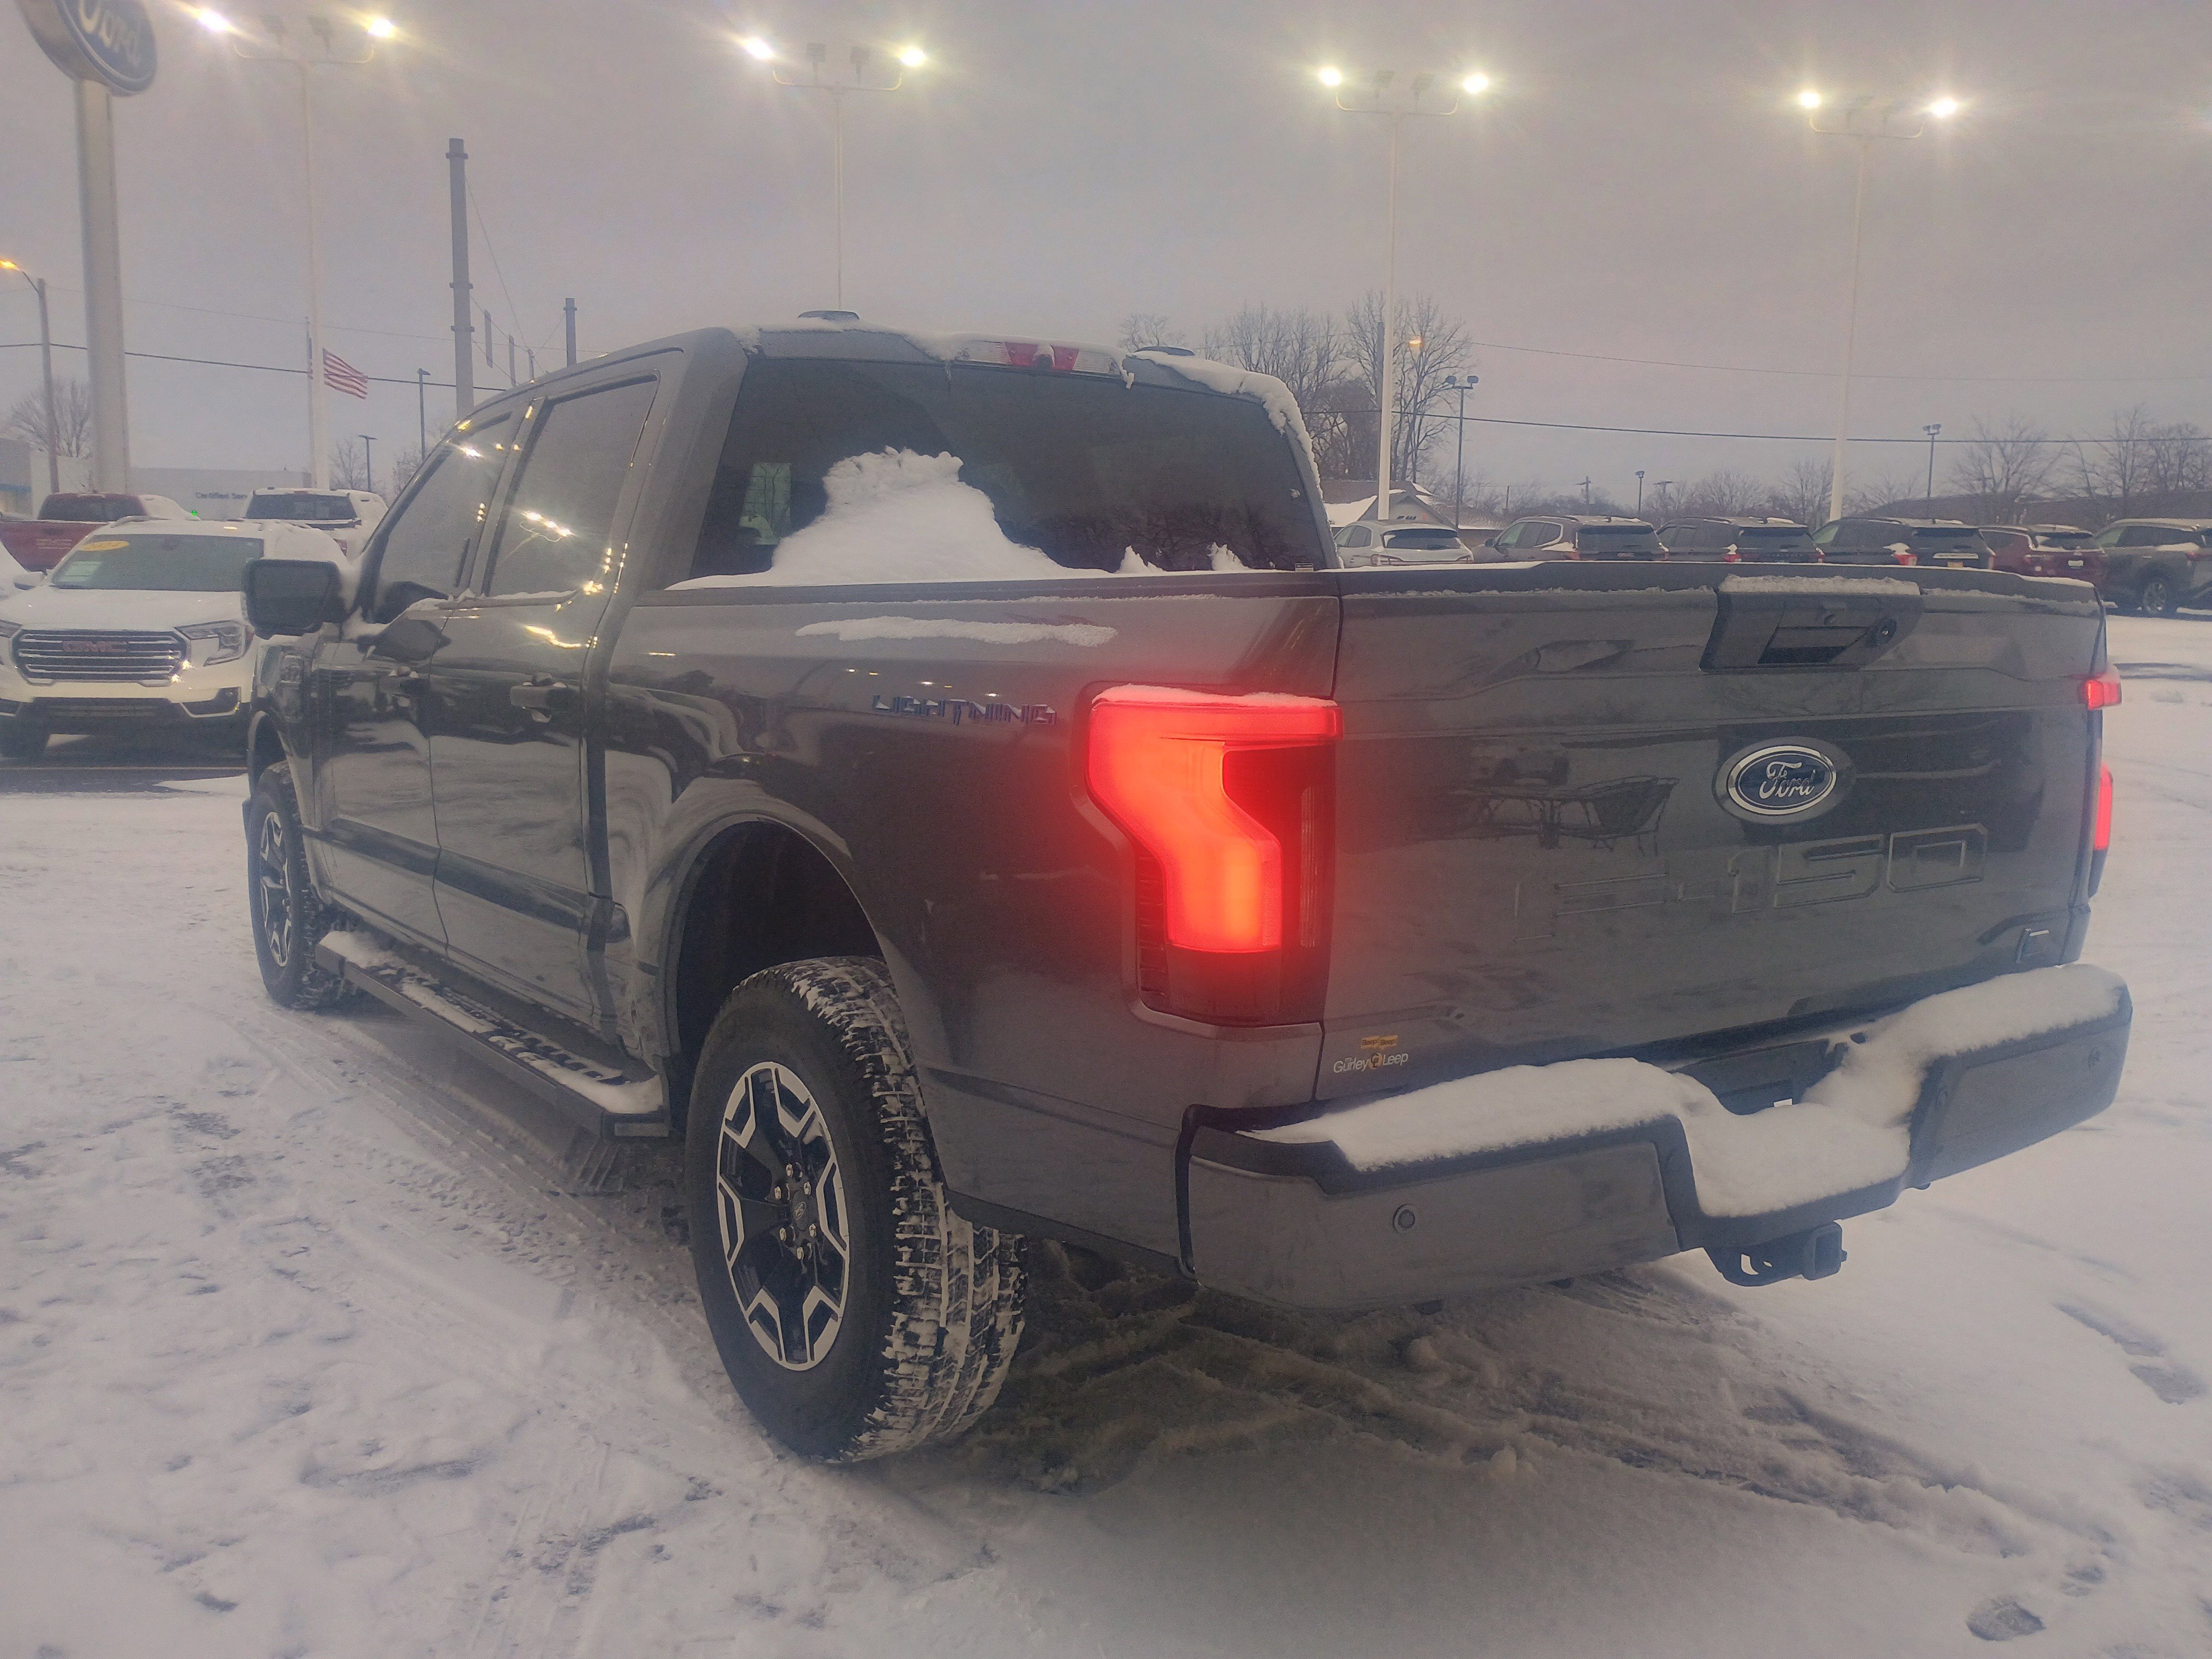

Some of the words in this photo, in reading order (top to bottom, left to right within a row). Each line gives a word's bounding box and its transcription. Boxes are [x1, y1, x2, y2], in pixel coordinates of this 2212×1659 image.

[63, 640, 127, 652] GMC
[872, 694, 1056, 726] LIGHTNING
[1759, 761, 1816, 799] Ford
[1333, 1057, 1370, 1074] Gurley
[1382, 1053, 1409, 1066] Leep
